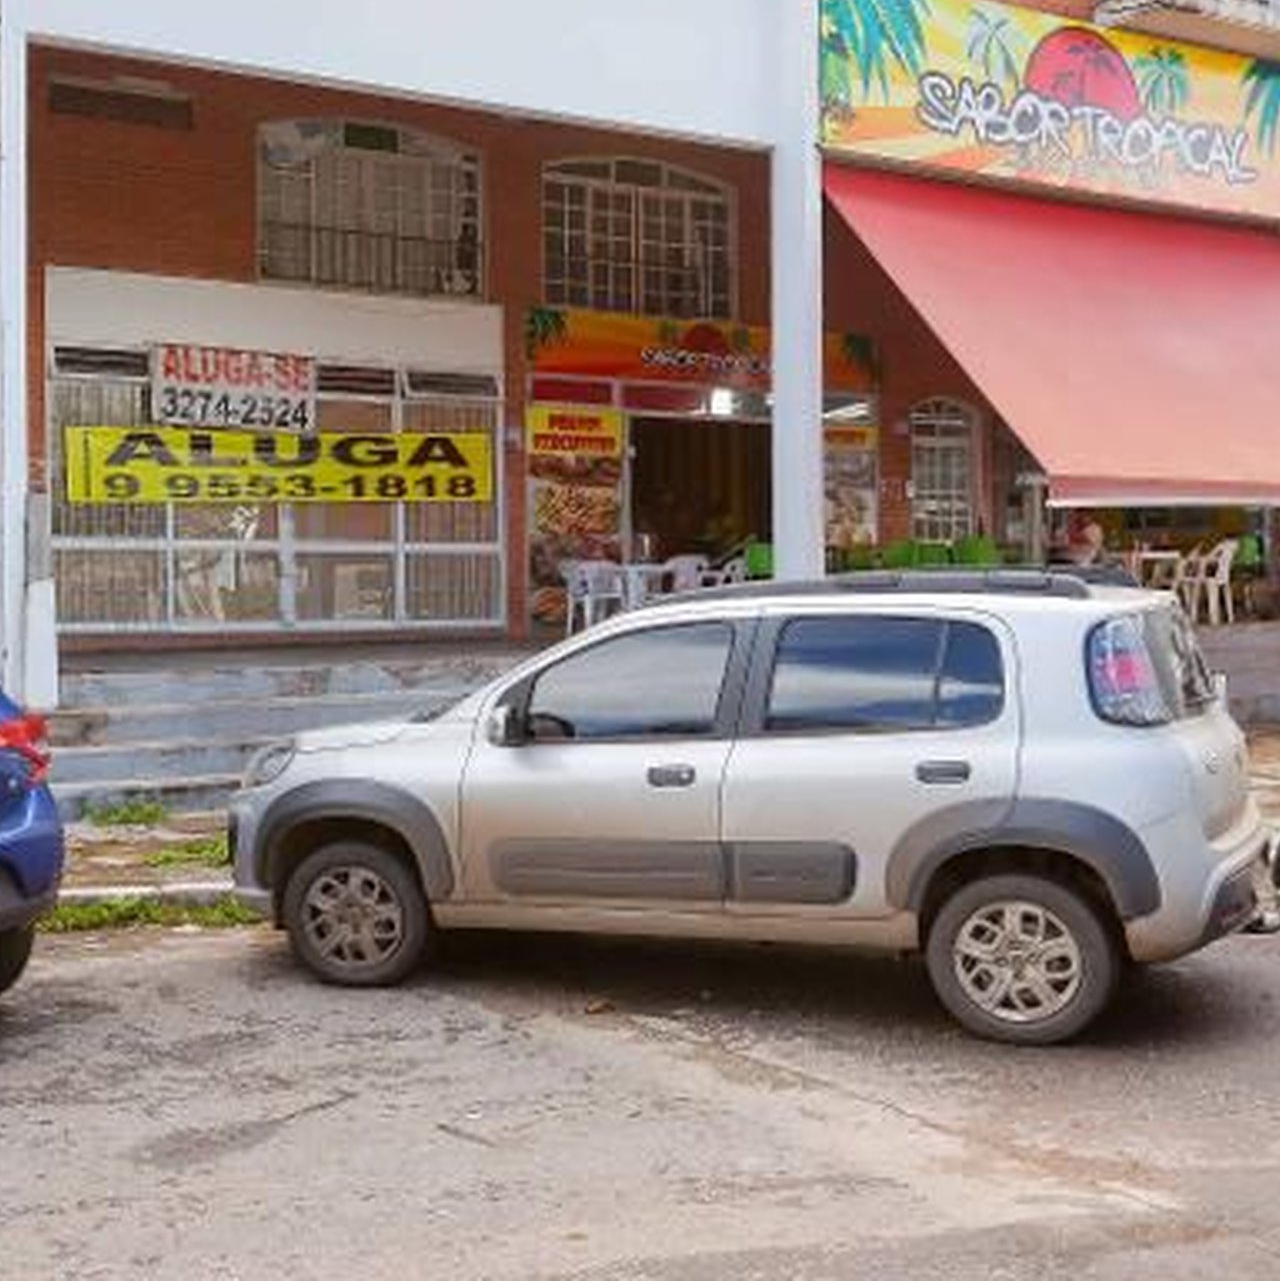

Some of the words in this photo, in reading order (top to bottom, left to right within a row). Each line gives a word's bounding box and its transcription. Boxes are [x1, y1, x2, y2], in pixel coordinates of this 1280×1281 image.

[918, 69, 1072, 152] SABOR
[1072, 103, 1260, 185] TROPICAL
[162, 343, 311, 394] ALUGA-SE
[105, 431, 469, 468] ALUGA
[104, 474, 139, 498] 9
[167, 474, 477, 498] 9553-1818
